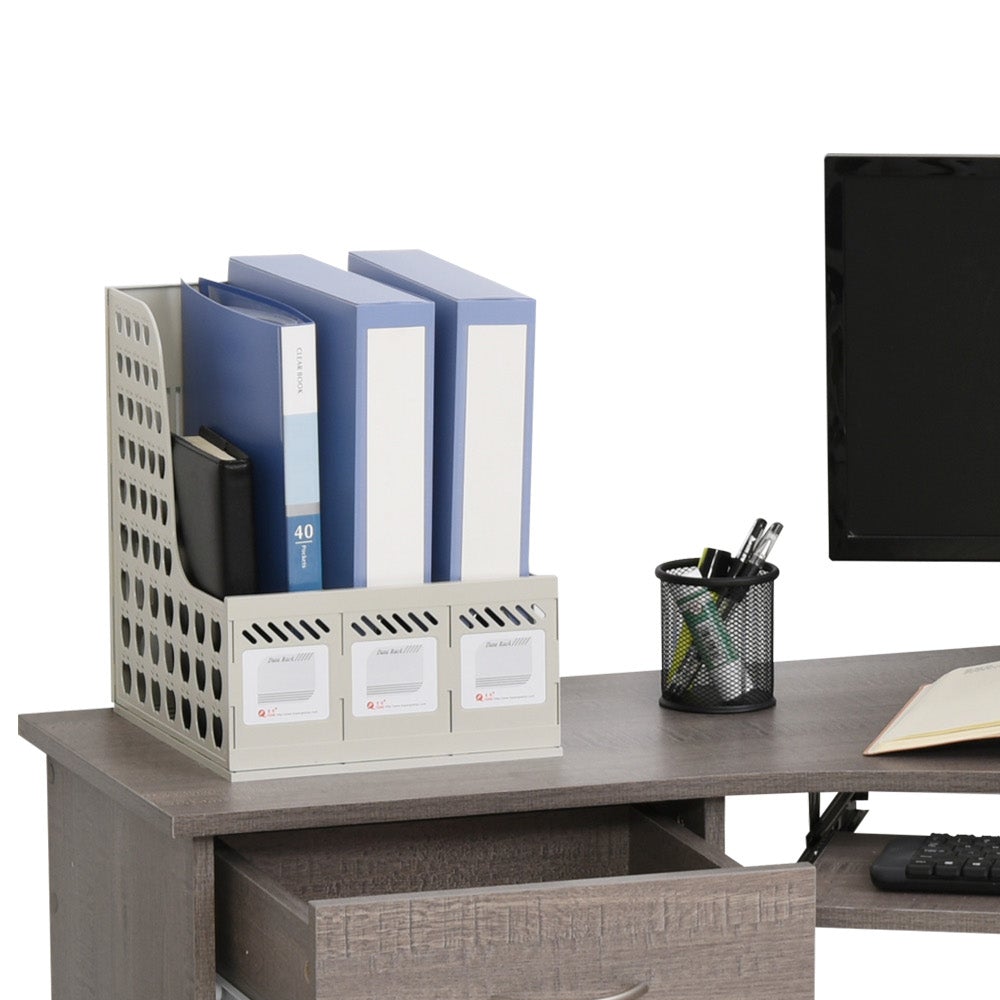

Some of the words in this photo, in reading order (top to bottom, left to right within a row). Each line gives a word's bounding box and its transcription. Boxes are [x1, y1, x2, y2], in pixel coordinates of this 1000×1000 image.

[295, 347, 303, 371] CLEAR
[296, 371, 304, 394] BOOK
[294, 523, 314, 540] 40
